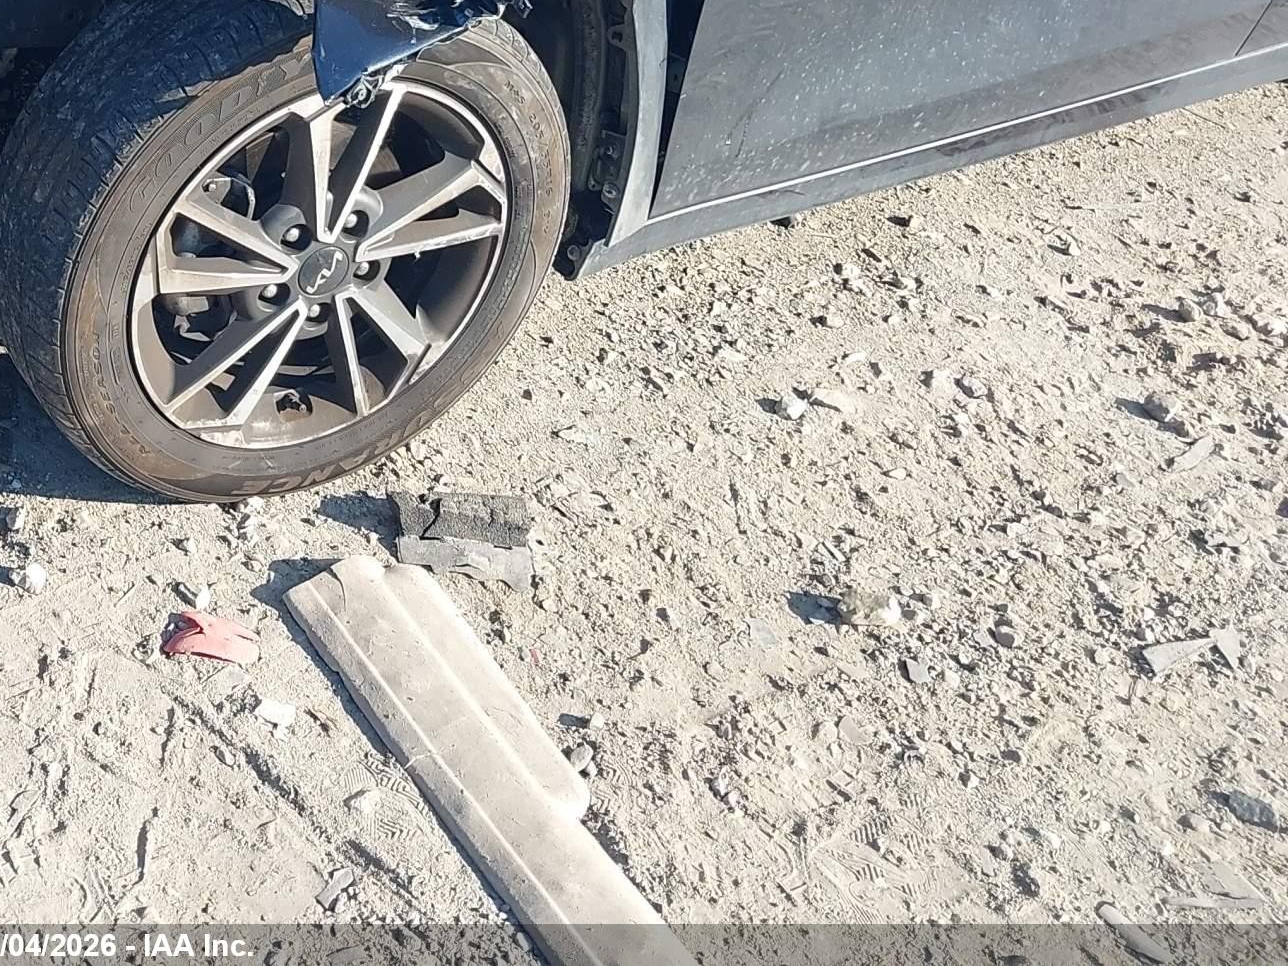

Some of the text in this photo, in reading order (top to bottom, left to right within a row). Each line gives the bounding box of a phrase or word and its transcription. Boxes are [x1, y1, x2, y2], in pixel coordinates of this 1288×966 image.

[129, 52, 314, 213] GOODY
[89, 330, 151, 455] ALL-SEASON
[230, 320, 505, 495] ASSURANCE
